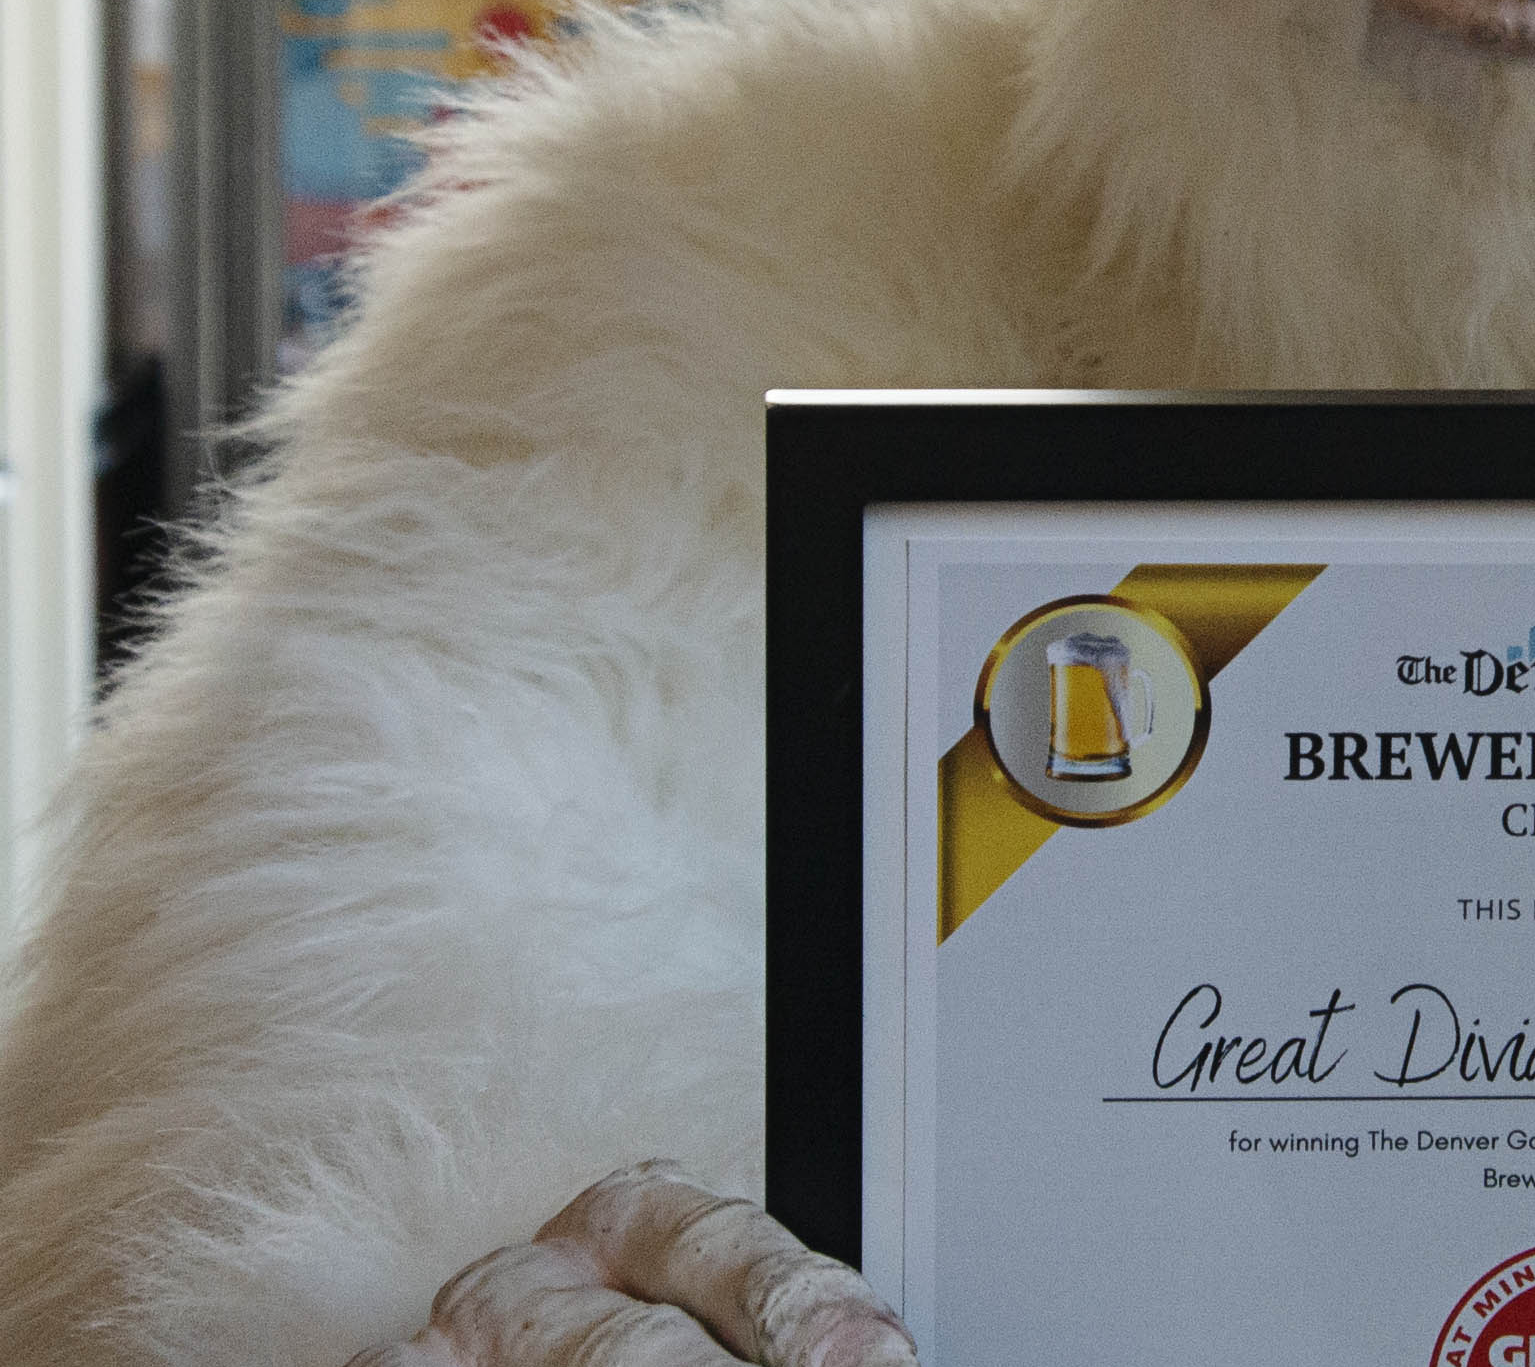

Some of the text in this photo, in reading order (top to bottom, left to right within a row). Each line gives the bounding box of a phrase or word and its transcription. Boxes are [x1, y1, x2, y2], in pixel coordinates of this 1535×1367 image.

[1396, 655, 1457, 685] The
[1458, 899, 1523, 921] THIS
[1152, 984, 1356, 1093] Great
[1228, 1130, 1261, 1152] for
[1269, 1133, 1359, 1157] winning
[1369, 1130, 1408, 1151] The
[1418, 1131, 1499, 1151] Denver
